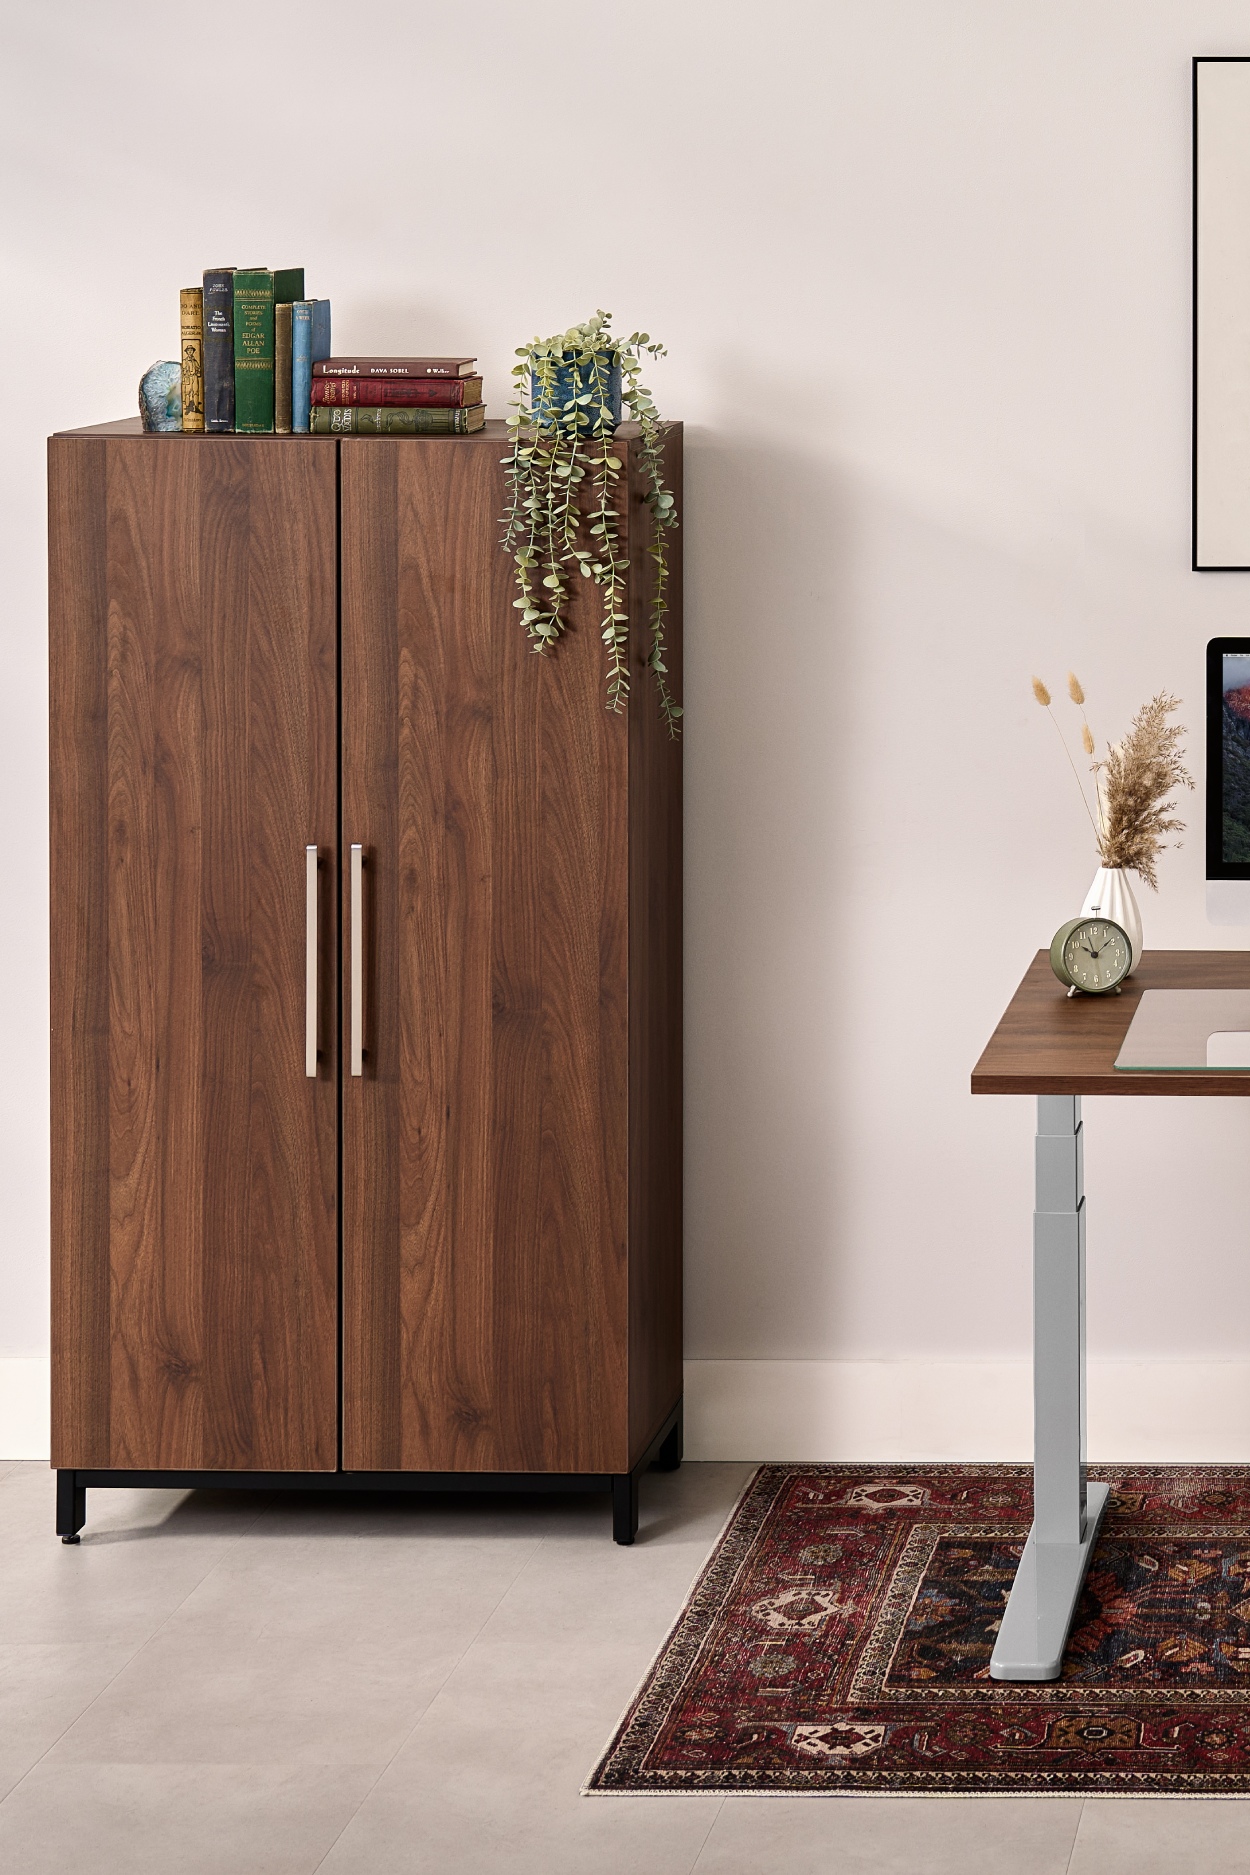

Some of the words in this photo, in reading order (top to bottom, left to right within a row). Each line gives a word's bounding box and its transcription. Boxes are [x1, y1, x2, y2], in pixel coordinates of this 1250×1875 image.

[323, 365, 360, 375] Longitude
[1090, 927, 1098, 935] 12
[1113, 959, 1118, 967] 4
